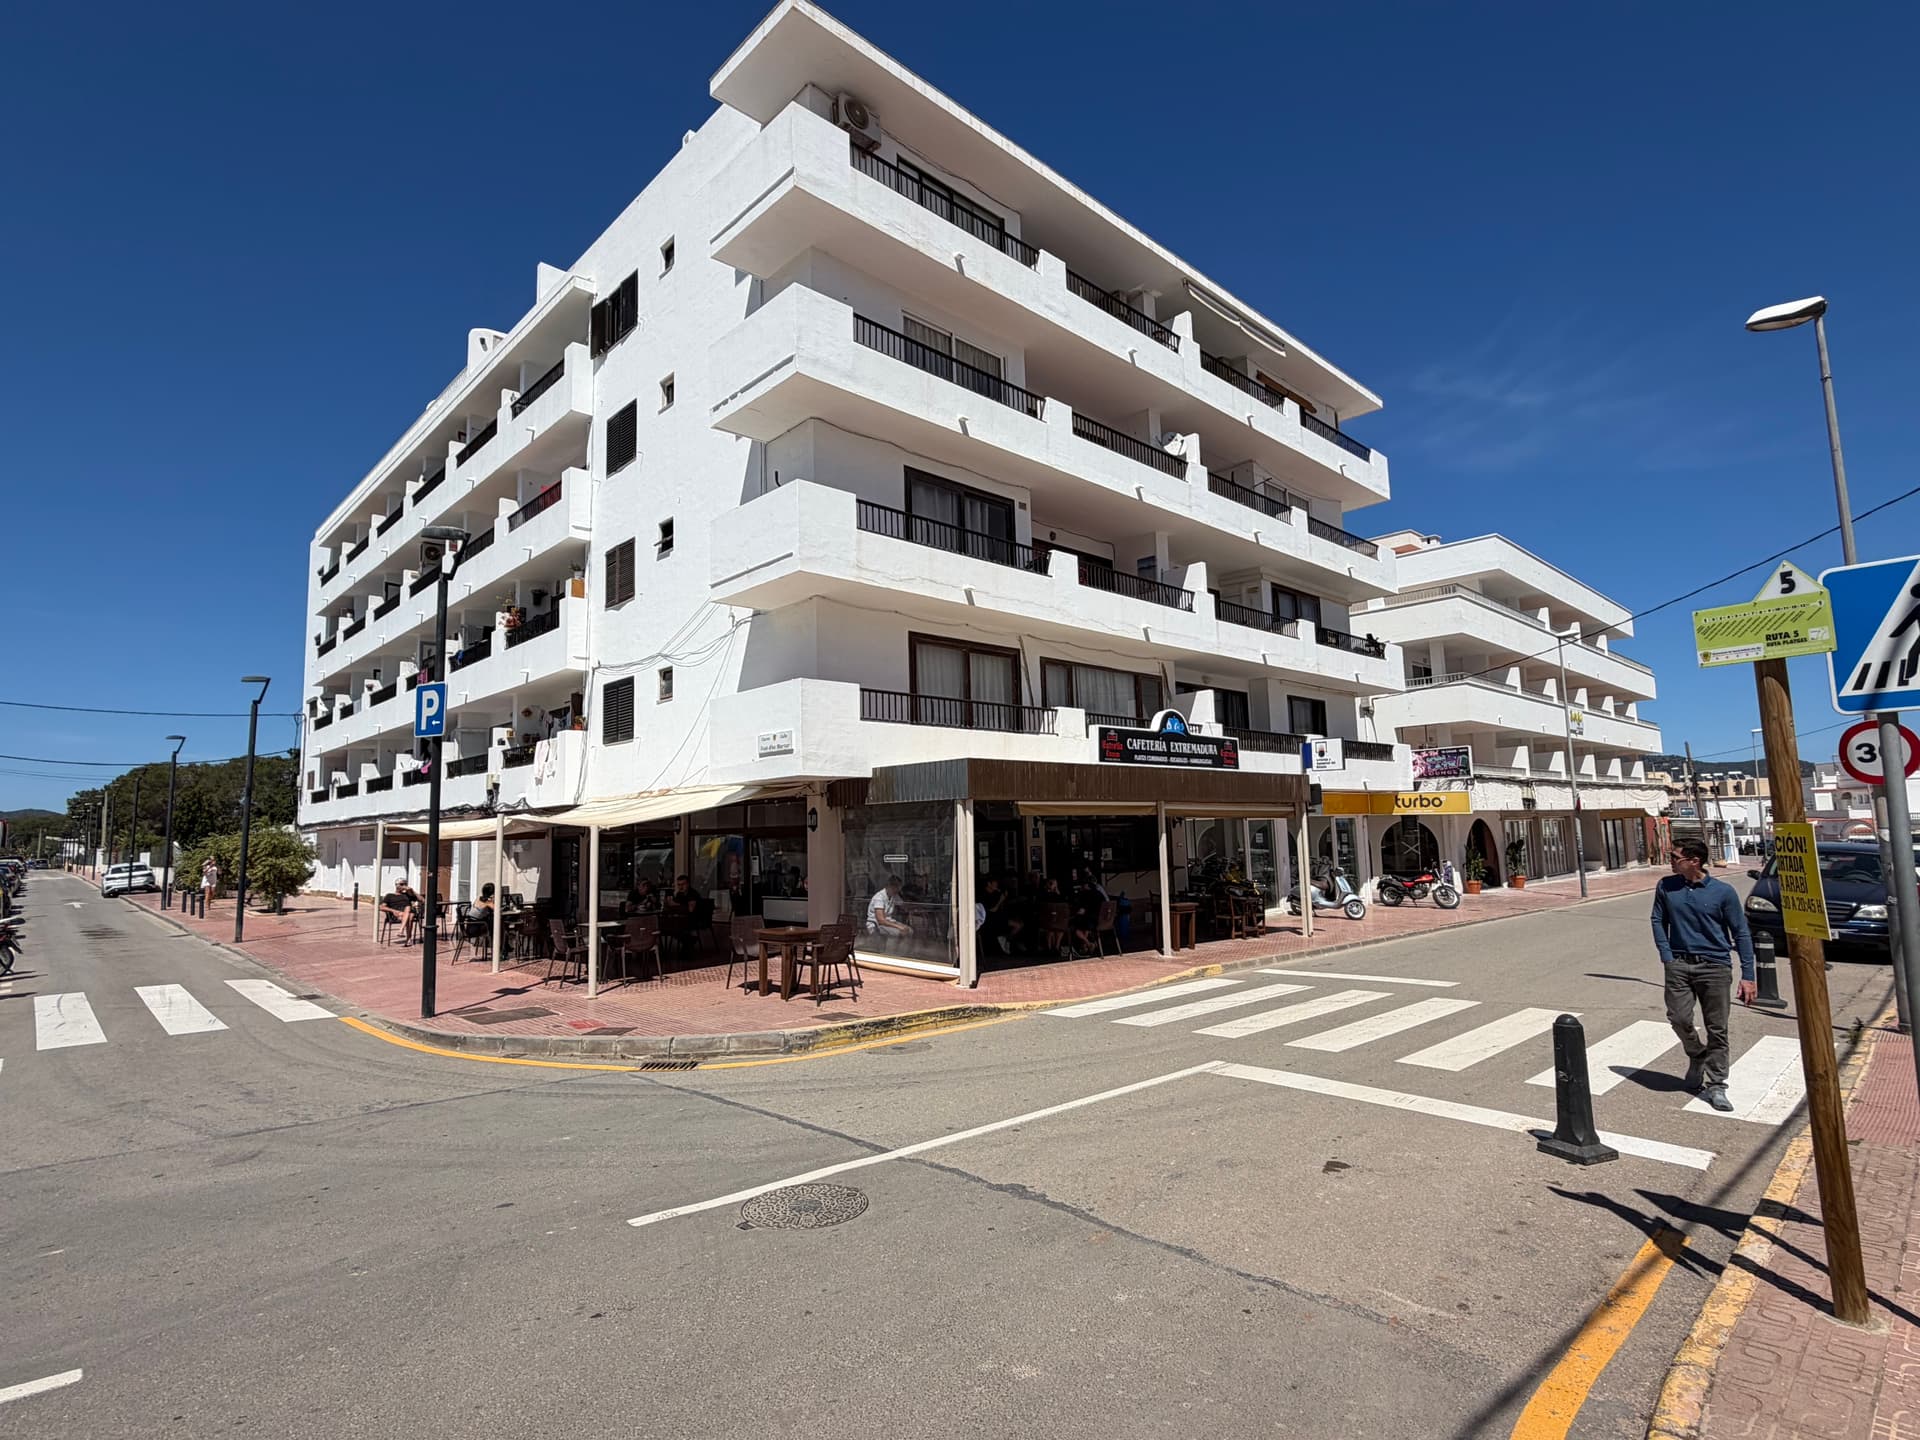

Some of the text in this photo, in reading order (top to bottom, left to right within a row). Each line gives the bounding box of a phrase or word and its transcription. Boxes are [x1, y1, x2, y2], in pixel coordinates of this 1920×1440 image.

[1779, 570, 1796, 594] 5
[1765, 630, 1800, 642] RUTA 5
[1766, 640, 1783, 648] RUTA
[421, 690, 440, 731] P
[1127, 737, 1218, 755] CAFETERÍA EXTREMADURA
[1856, 743, 1882, 763] 3
[1394, 794, 1443, 809] turbo
[1775, 832, 1808, 853] CIÓN!
[1785, 872, 1808, 894] ARABÍ
